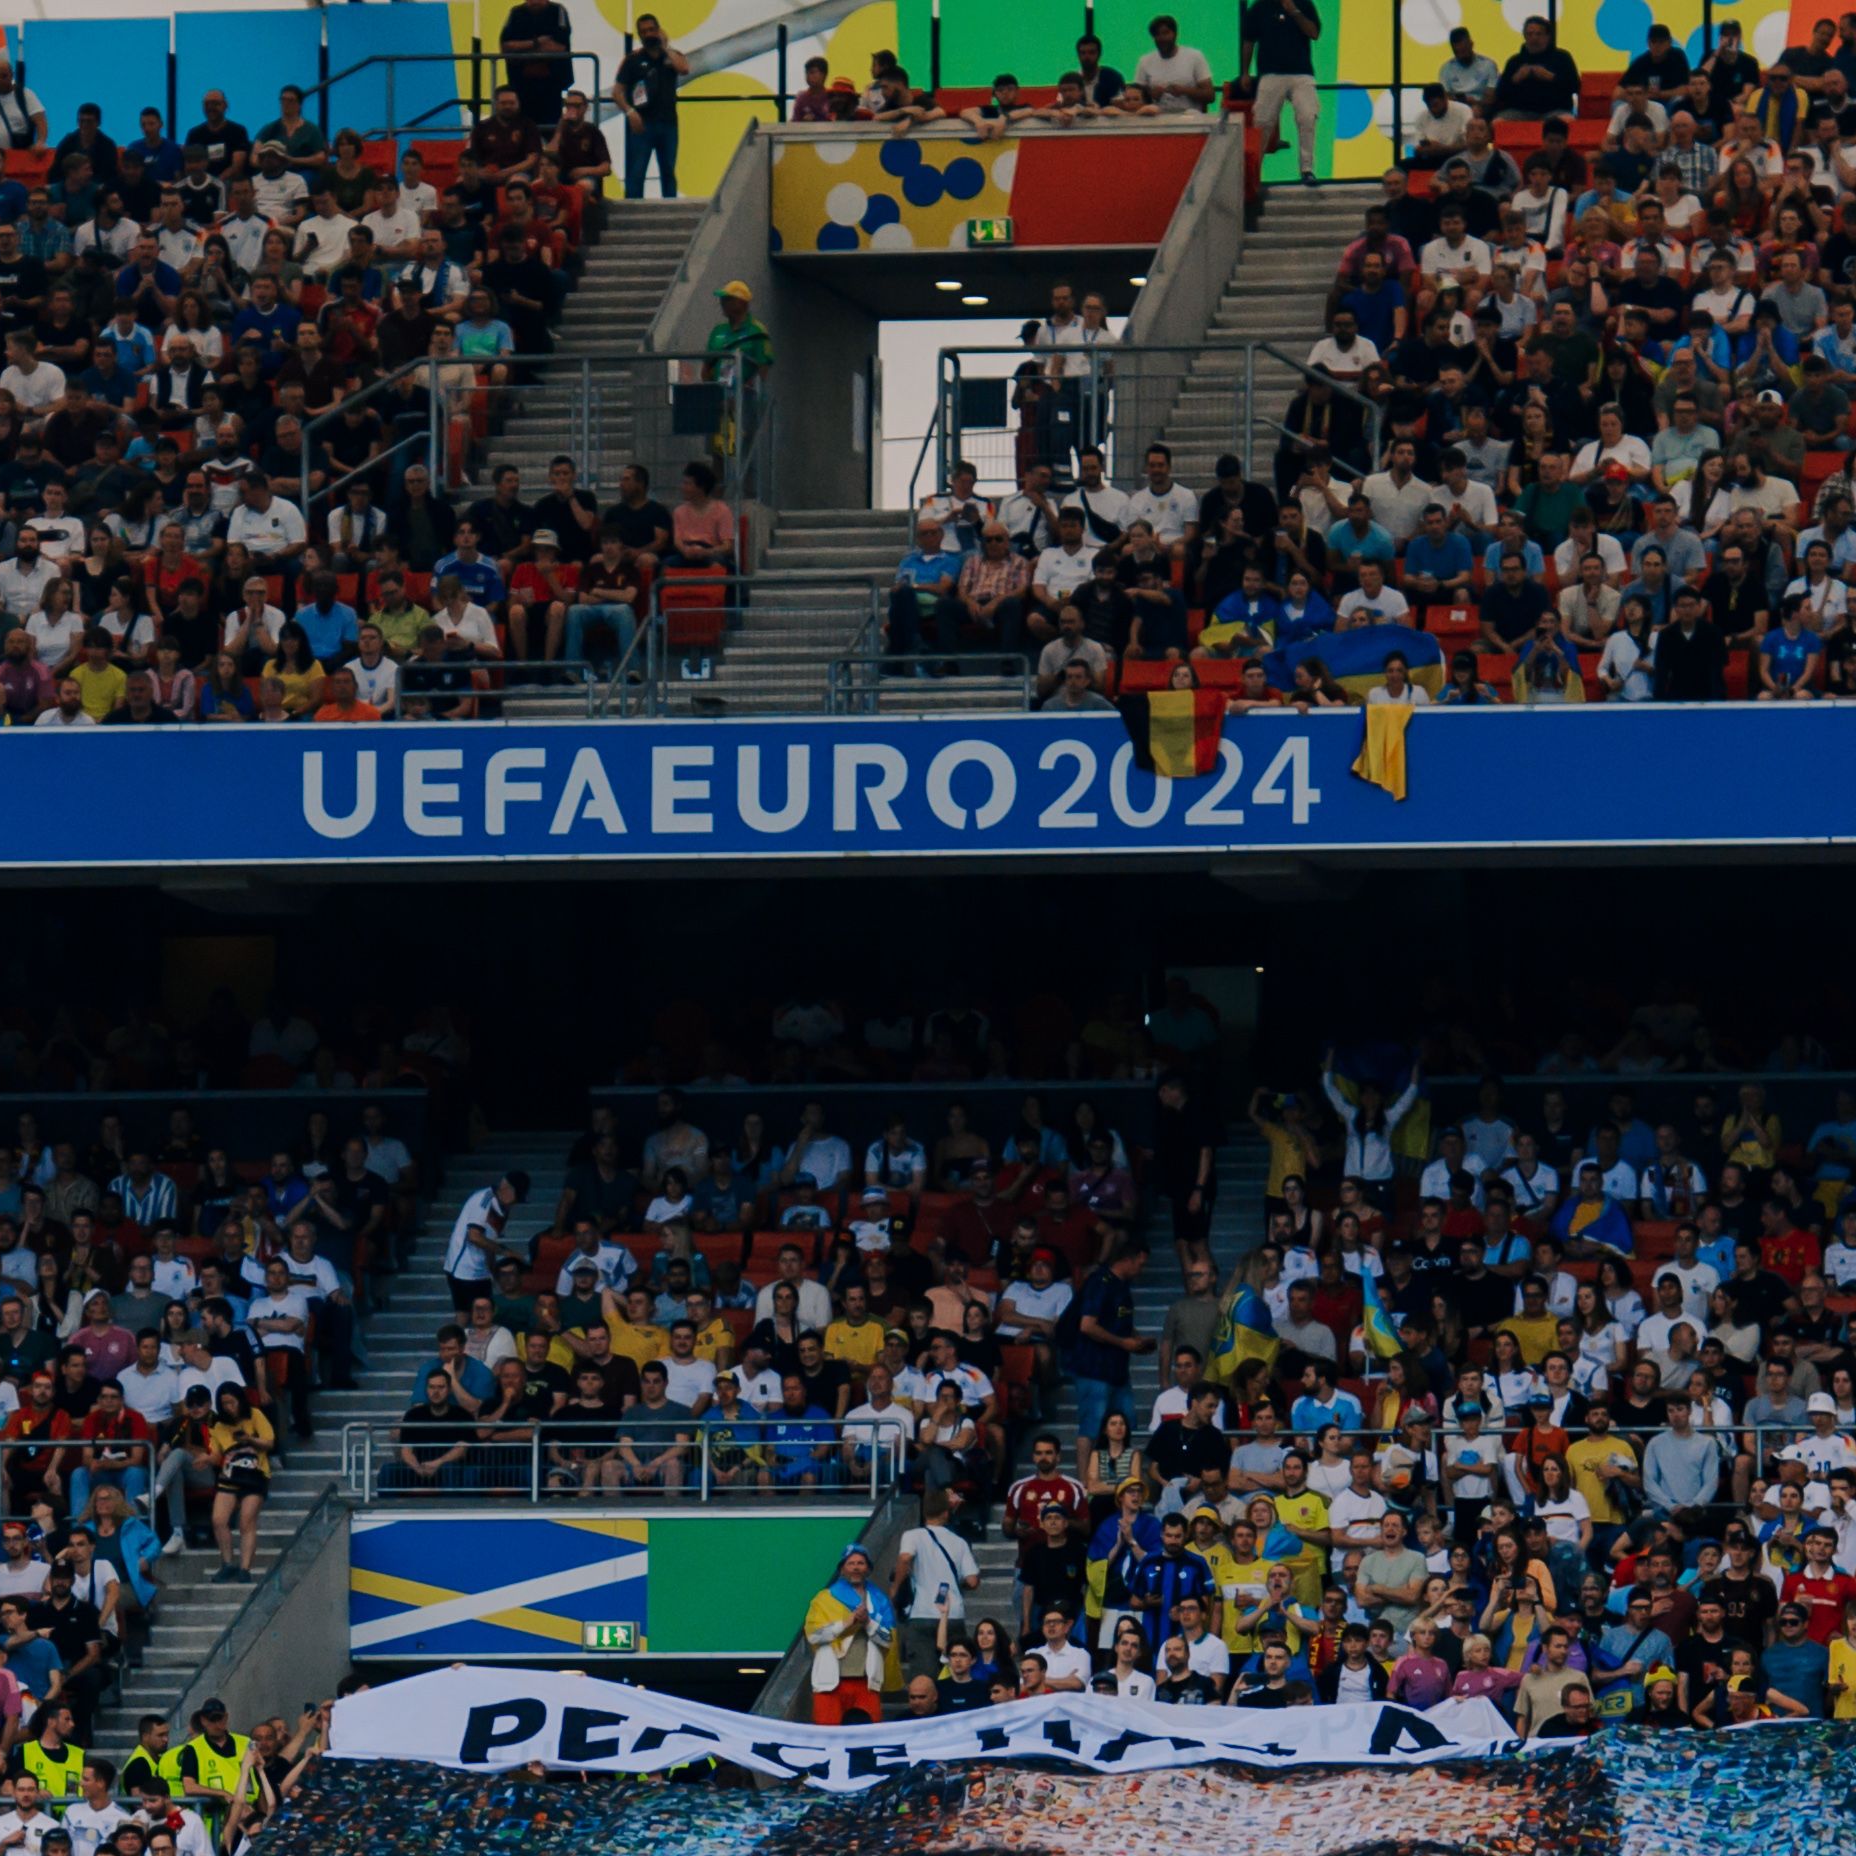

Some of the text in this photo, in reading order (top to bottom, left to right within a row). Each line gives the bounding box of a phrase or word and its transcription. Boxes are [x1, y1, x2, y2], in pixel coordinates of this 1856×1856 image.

[303, 736, 1321, 839] UEFA EURO 2024
